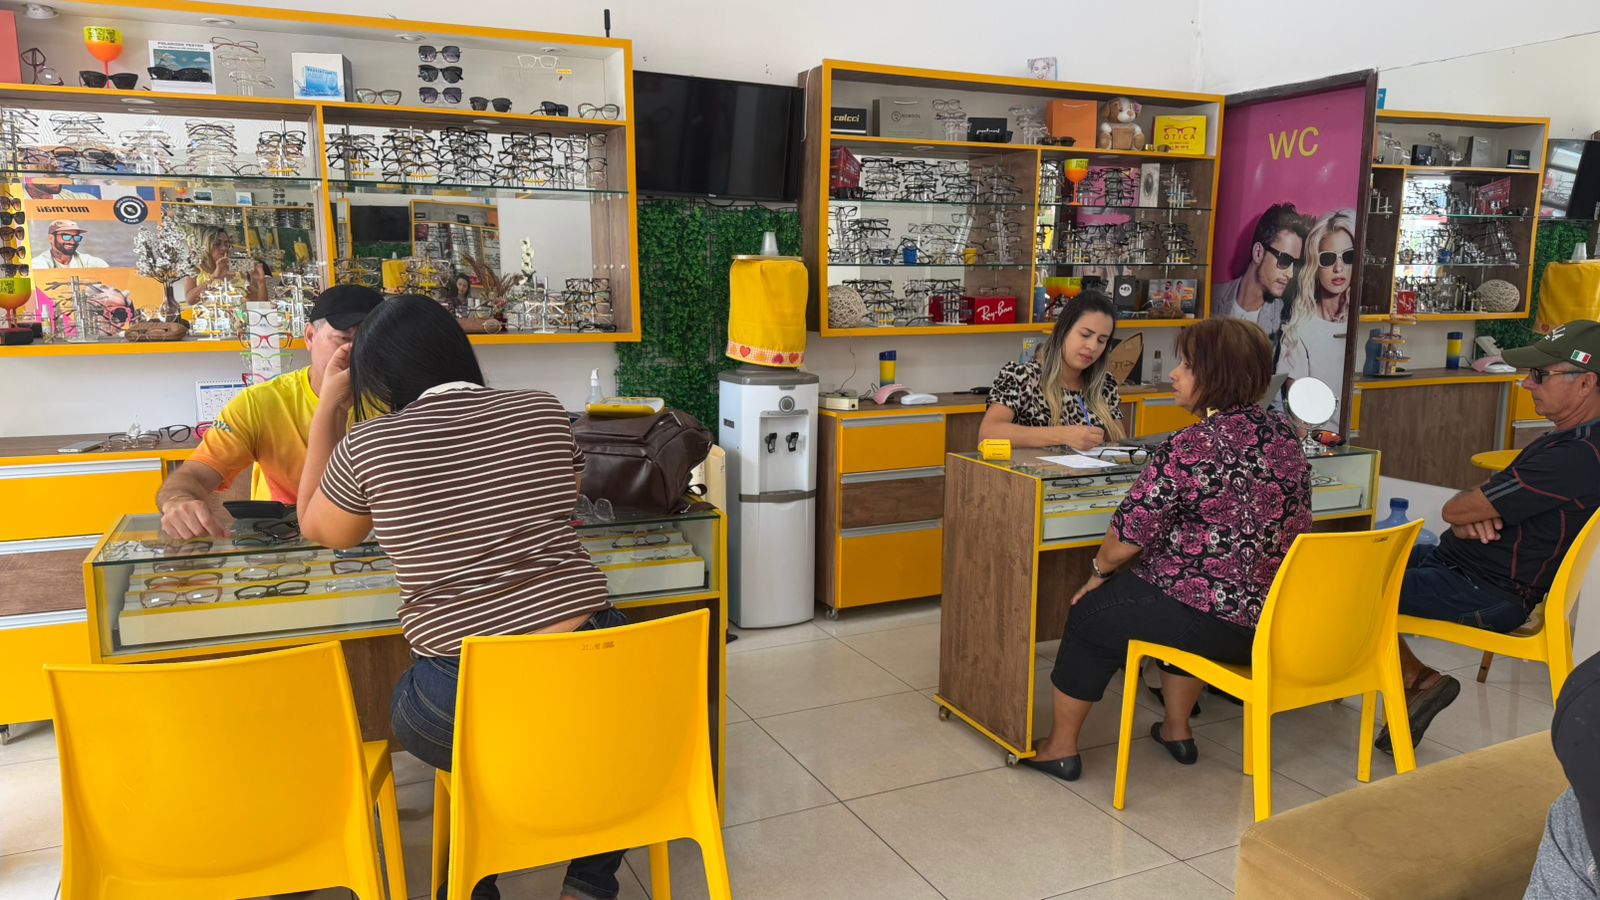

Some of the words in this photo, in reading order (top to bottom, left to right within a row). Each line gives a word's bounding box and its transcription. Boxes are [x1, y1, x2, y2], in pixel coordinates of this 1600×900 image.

[833, 113, 860, 122] colcci
[1268, 127, 1319, 160] WC
[976, 300, 1013, 321] Ray-Ban
